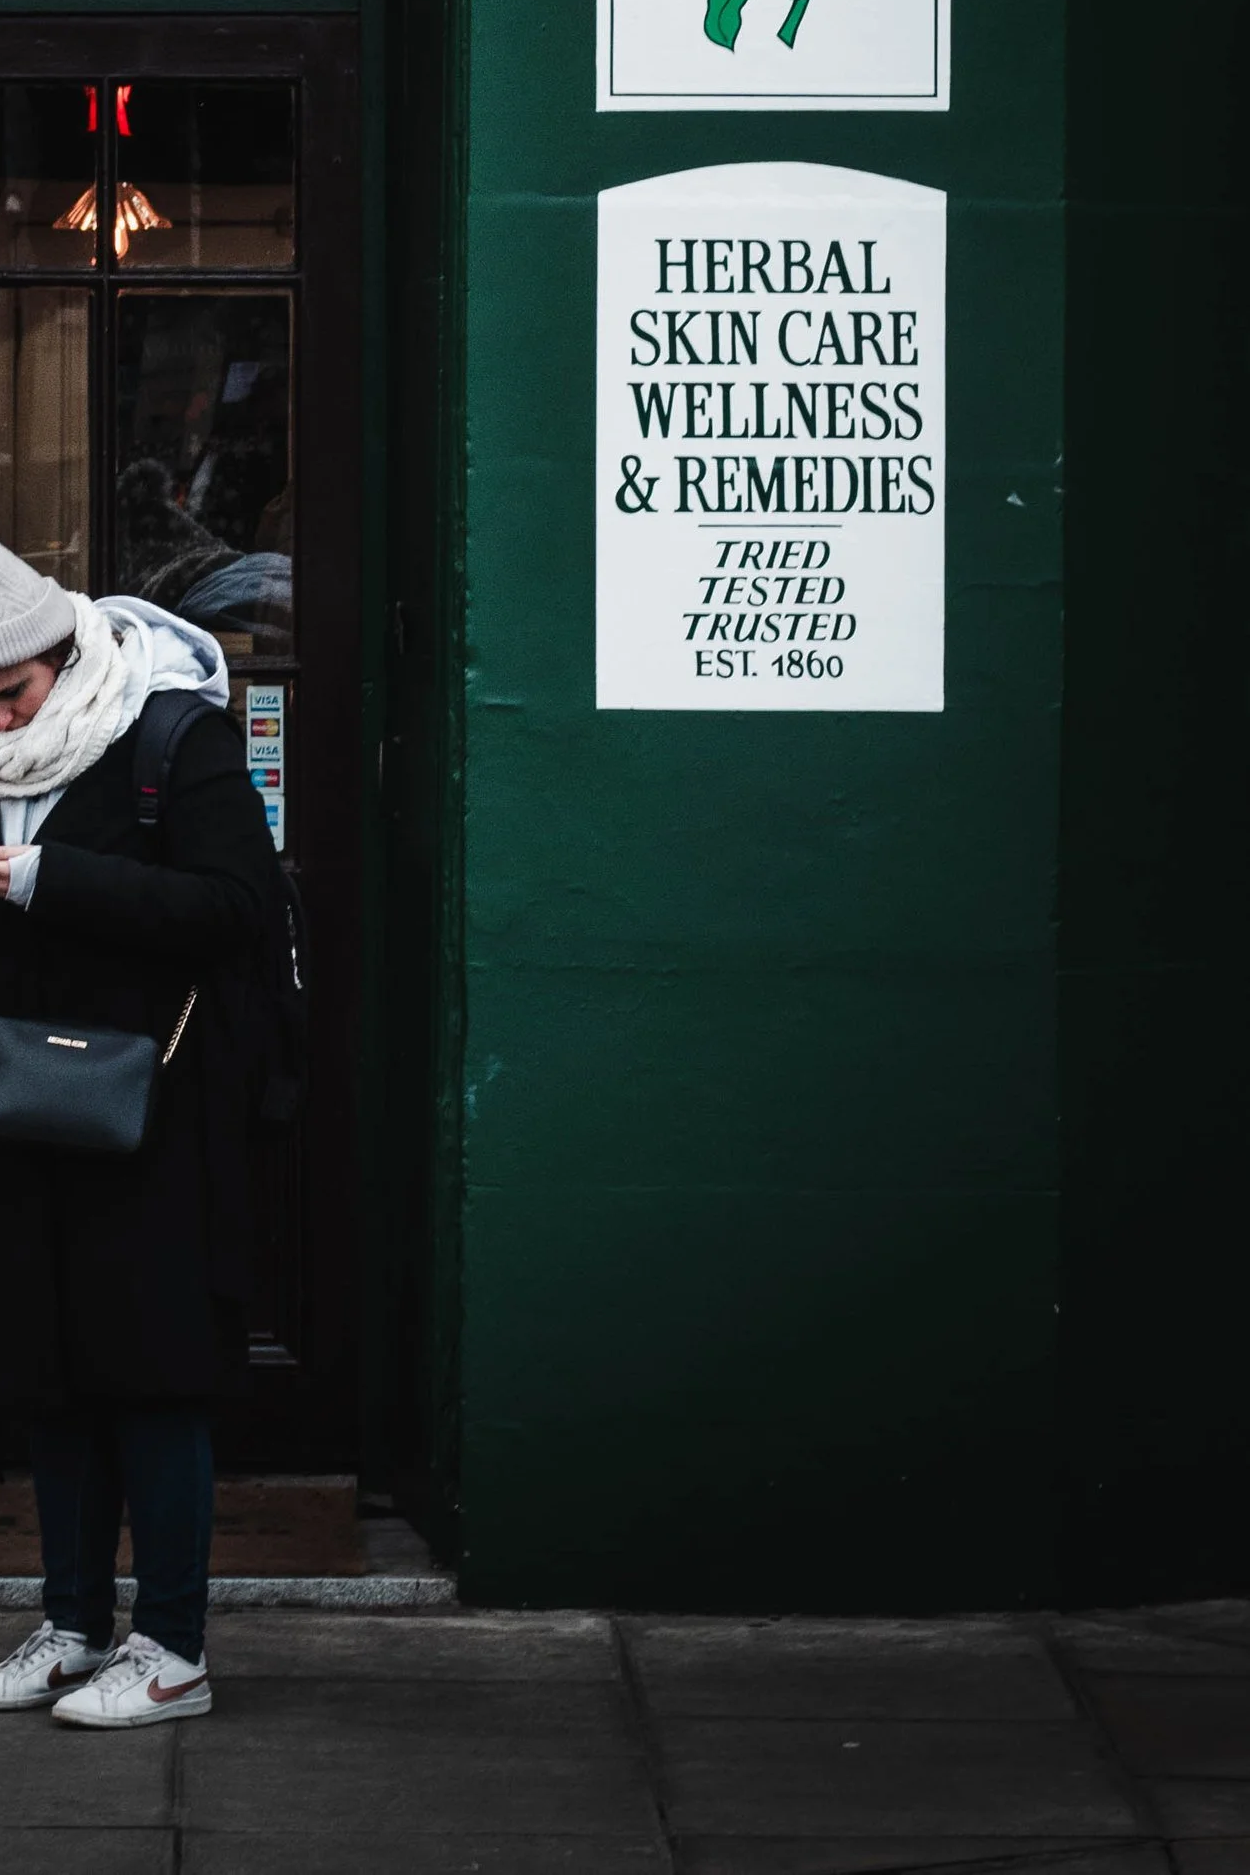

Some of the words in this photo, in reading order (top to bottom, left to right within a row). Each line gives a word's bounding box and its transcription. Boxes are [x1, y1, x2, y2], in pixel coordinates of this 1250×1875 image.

[655, 239, 890, 293] HERBAL
[631, 310, 761, 366] SKIN
[779, 310, 918, 366] CARE
[627, 382, 922, 440] WELLNESS
[615, 455, 660, 514] &
[674, 455, 934, 515] REMEDIES
[717, 541, 830, 570] TRIED
[699, 577, 845, 606] TESTED
[683, 613, 856, 642] TRUSTED
[696, 650, 757, 678] EST.
[772, 650, 843, 678] 1860
[254, 695, 279, 705] VISA
[254, 745, 279, 755] VISA
